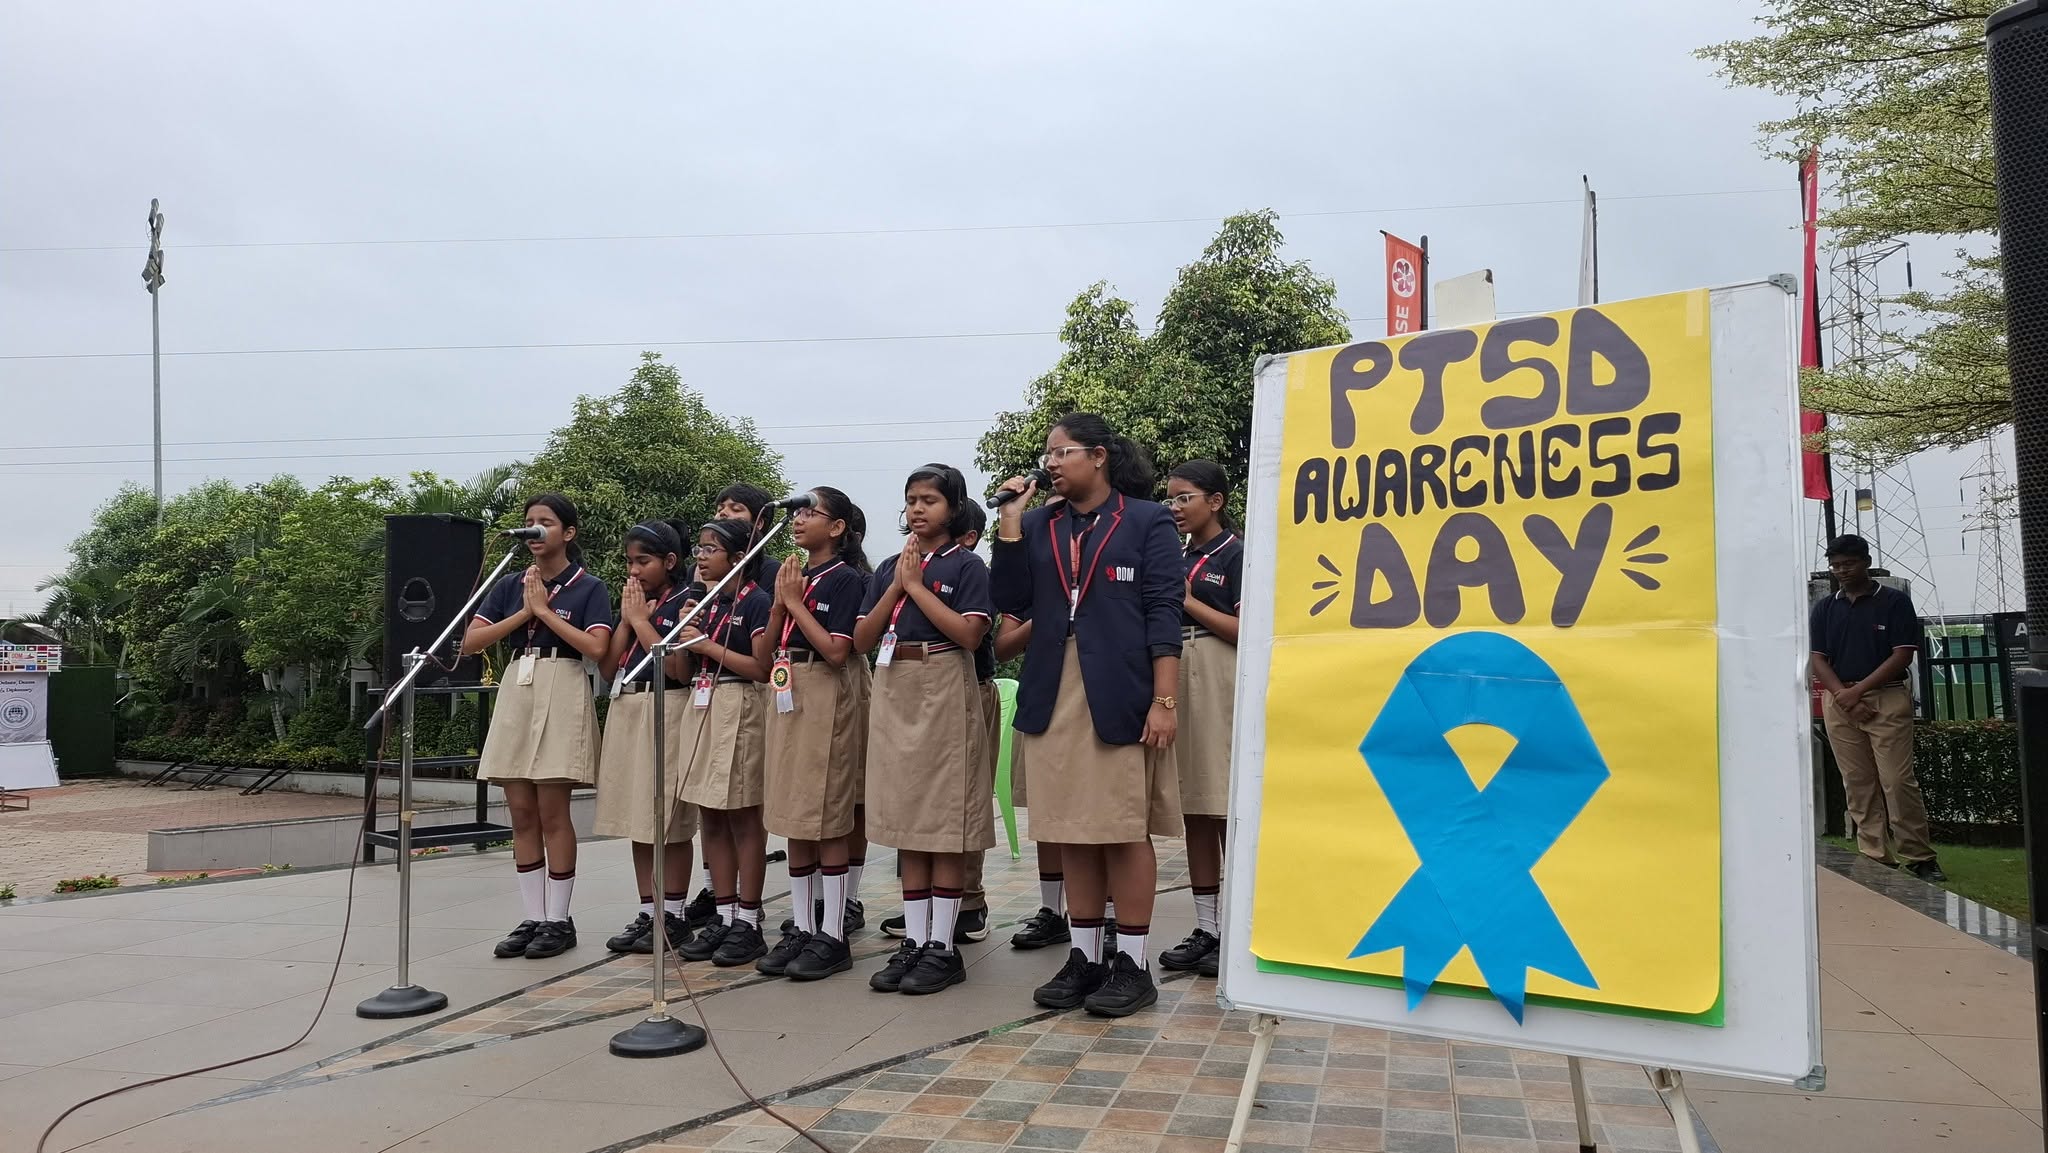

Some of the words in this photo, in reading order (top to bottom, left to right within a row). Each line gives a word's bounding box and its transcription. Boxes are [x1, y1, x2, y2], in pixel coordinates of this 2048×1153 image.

[1394, 304, 1409, 335] SE
[1330, 307, 1651, 449] PTSD
[1293, 412, 1681, 525] AWARENESS
[1116, 566, 1135, 582] ODM
[1349, 502, 1613, 629] DAY
[940, 584, 954, 594] ODM
[816, 602, 830, 613] ODM
